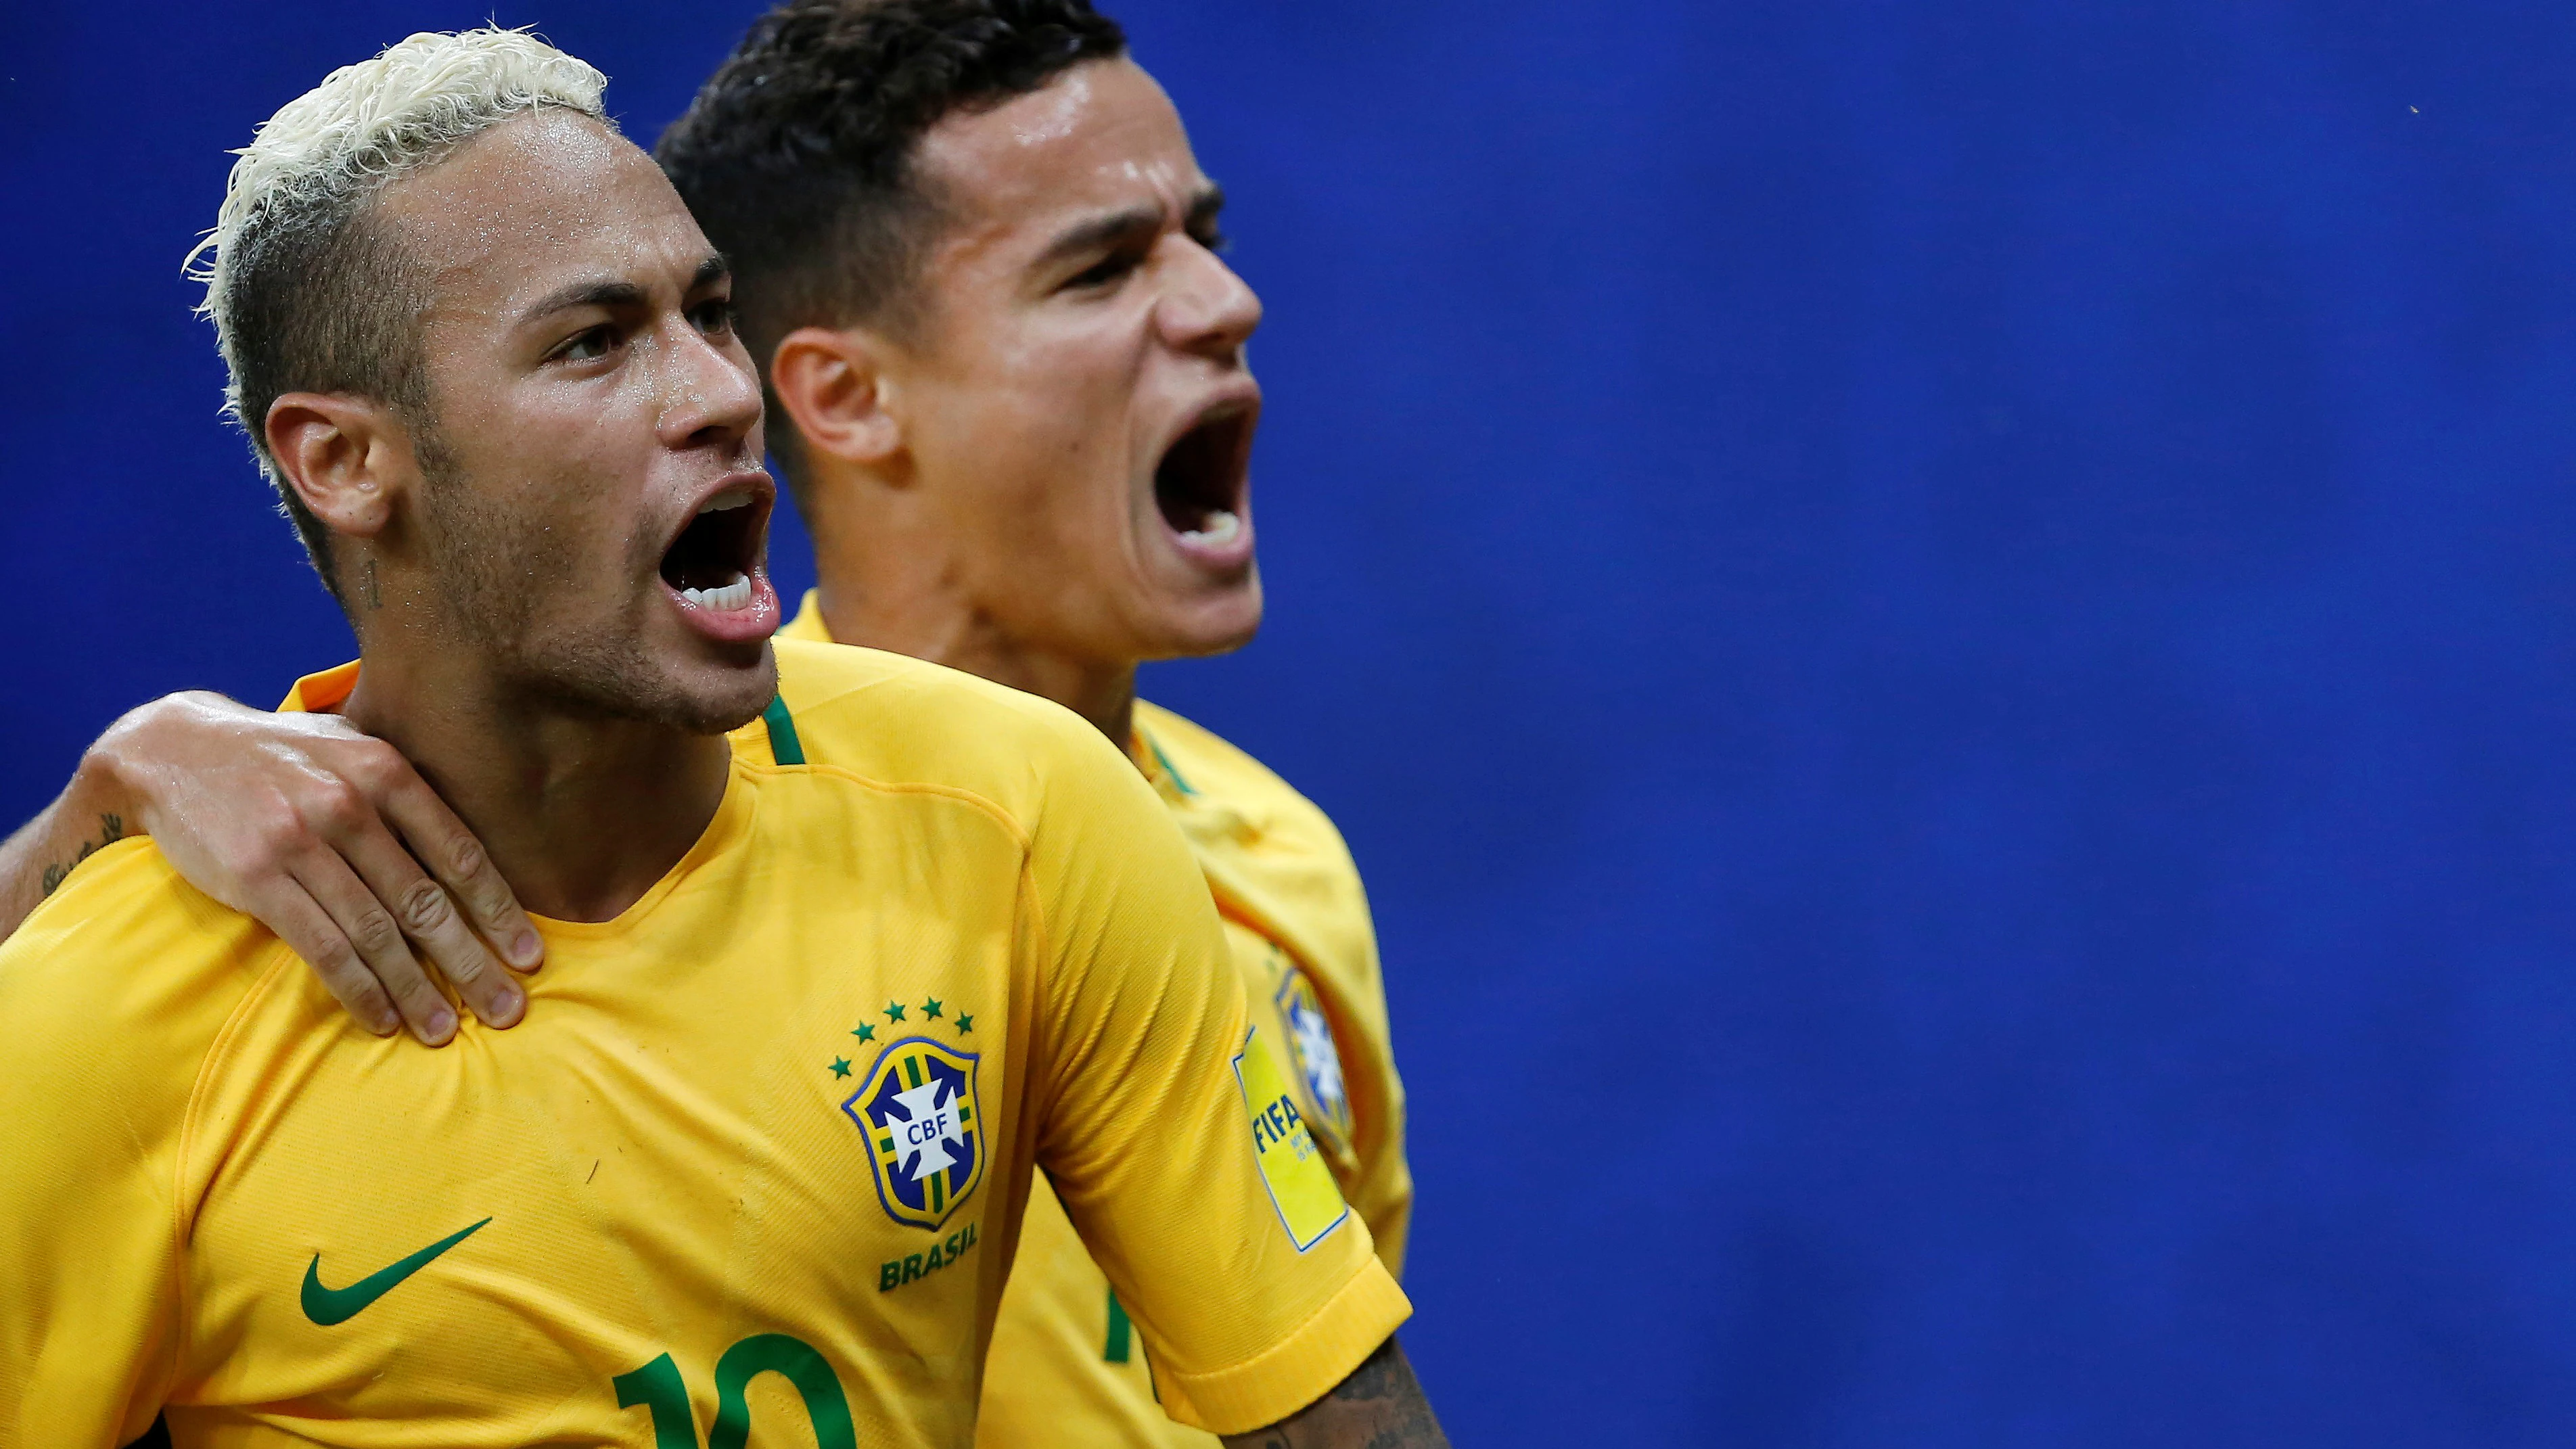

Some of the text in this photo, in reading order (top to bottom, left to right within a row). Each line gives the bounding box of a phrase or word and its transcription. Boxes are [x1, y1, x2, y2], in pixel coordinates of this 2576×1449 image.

[906, 1113, 948, 1146] CBF
[1253, 1094, 1300, 1153] FIFA
[879, 1222, 978, 1292] BRASIL
